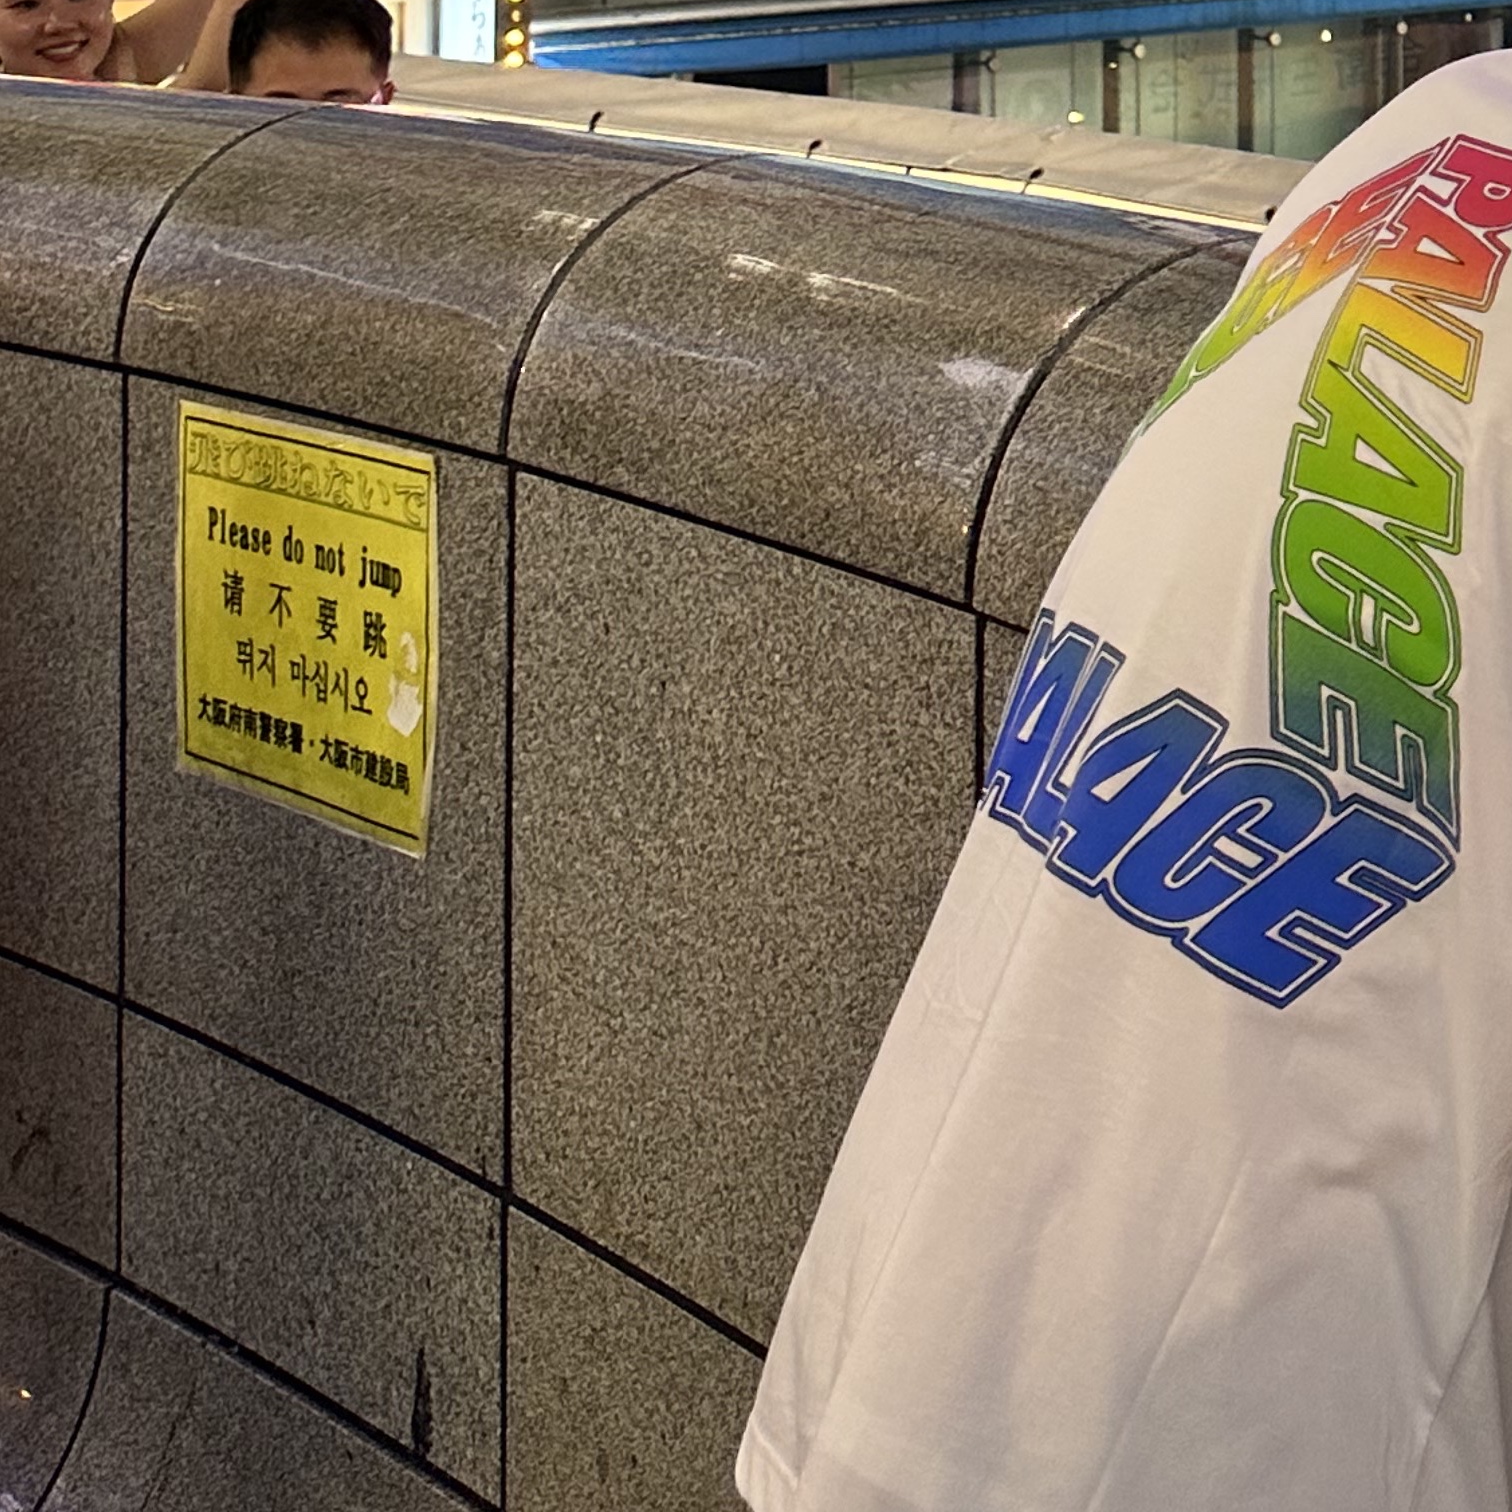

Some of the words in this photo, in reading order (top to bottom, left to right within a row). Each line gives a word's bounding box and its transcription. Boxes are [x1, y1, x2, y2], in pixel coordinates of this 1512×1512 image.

[207, 505, 272, 556] Please
[282, 524, 305, 565] do
[314, 541, 346, 578] not
[358, 545, 403, 598] jump
[289, 653, 373, 716] 마십시오
